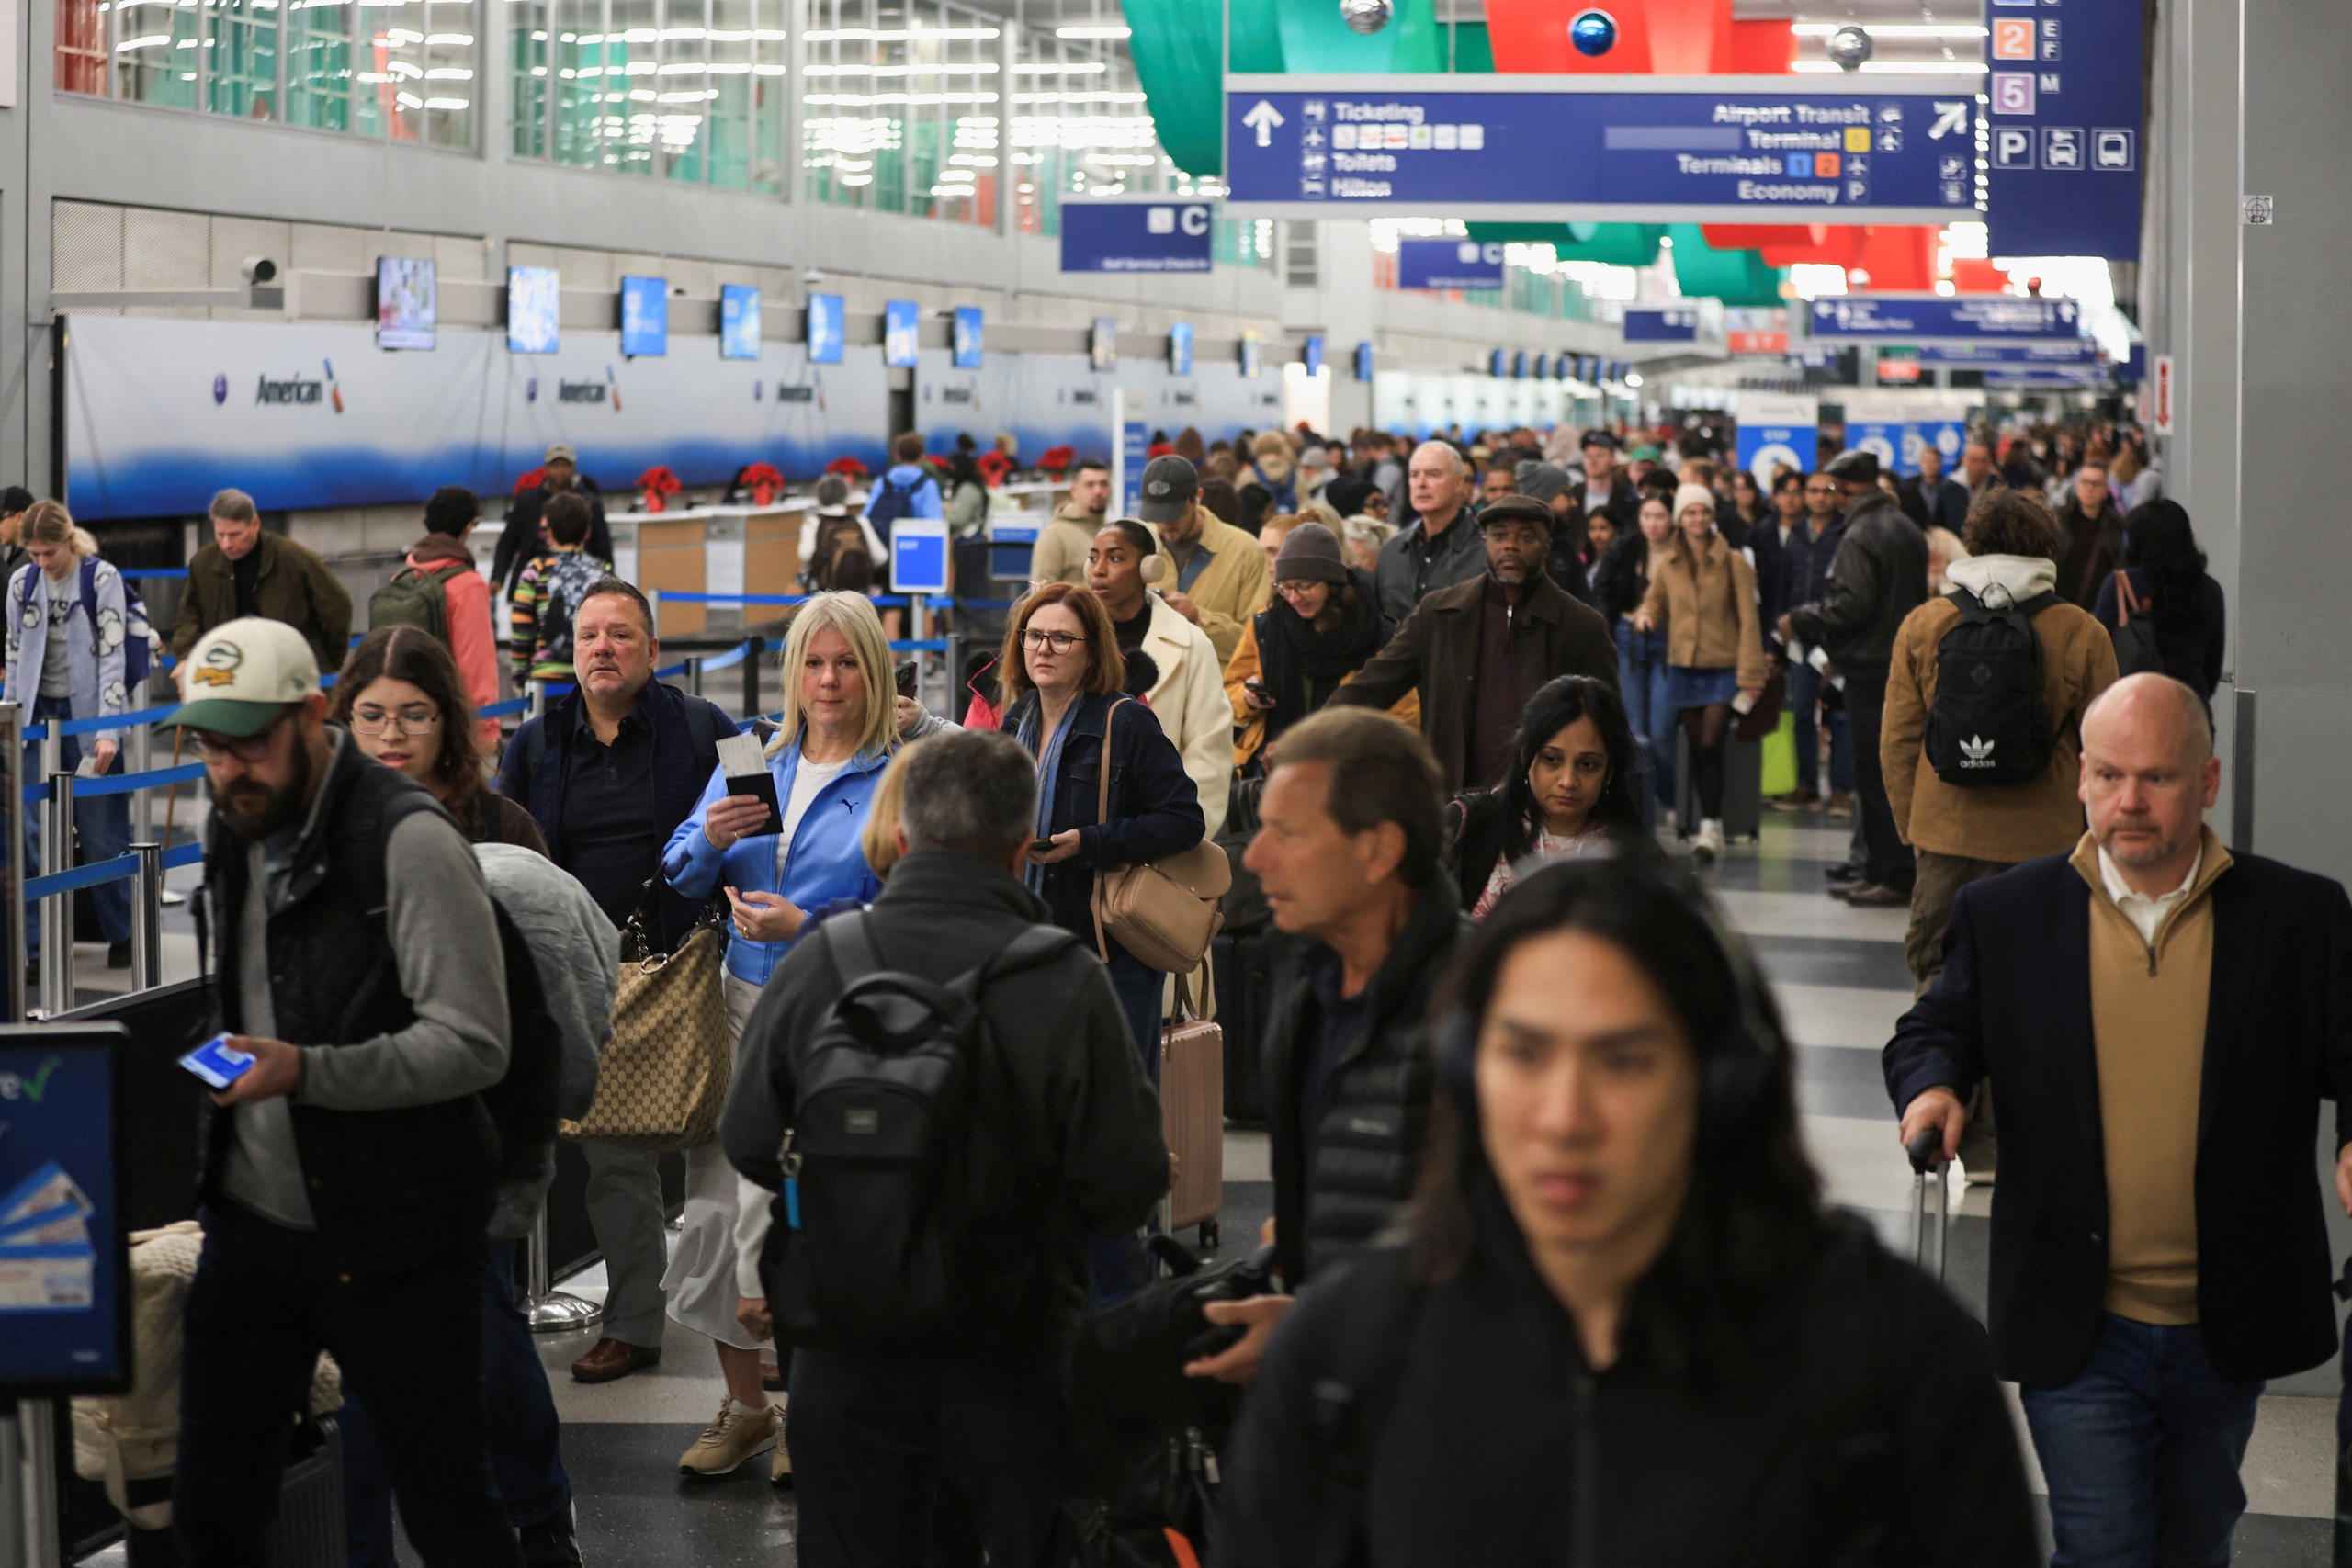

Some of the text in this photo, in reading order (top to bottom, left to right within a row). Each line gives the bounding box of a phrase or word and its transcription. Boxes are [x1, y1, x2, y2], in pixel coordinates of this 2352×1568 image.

[2003, 20, 2058, 54] 2 E
[2042, 41, 2058, 59] F
[2001, 75, 2059, 108] 5 M
[1332, 102, 1425, 125] Ticketing
[1713, 104, 1871, 127] Airport Transit
[1747, 129, 1840, 150] Terminal
[1999, 131, 2027, 164] P
[1331, 152, 1397, 172] Toilets
[1676, 153, 1783, 175] Terminals
[1331, 177, 1392, 197] Hilton
[1737, 181, 1839, 204] Economy
[1181, 205, 1209, 236] C
[255, 372, 322, 405] American
[559, 377, 605, 403] American
[1960, 759, 1996, 769] adidas
